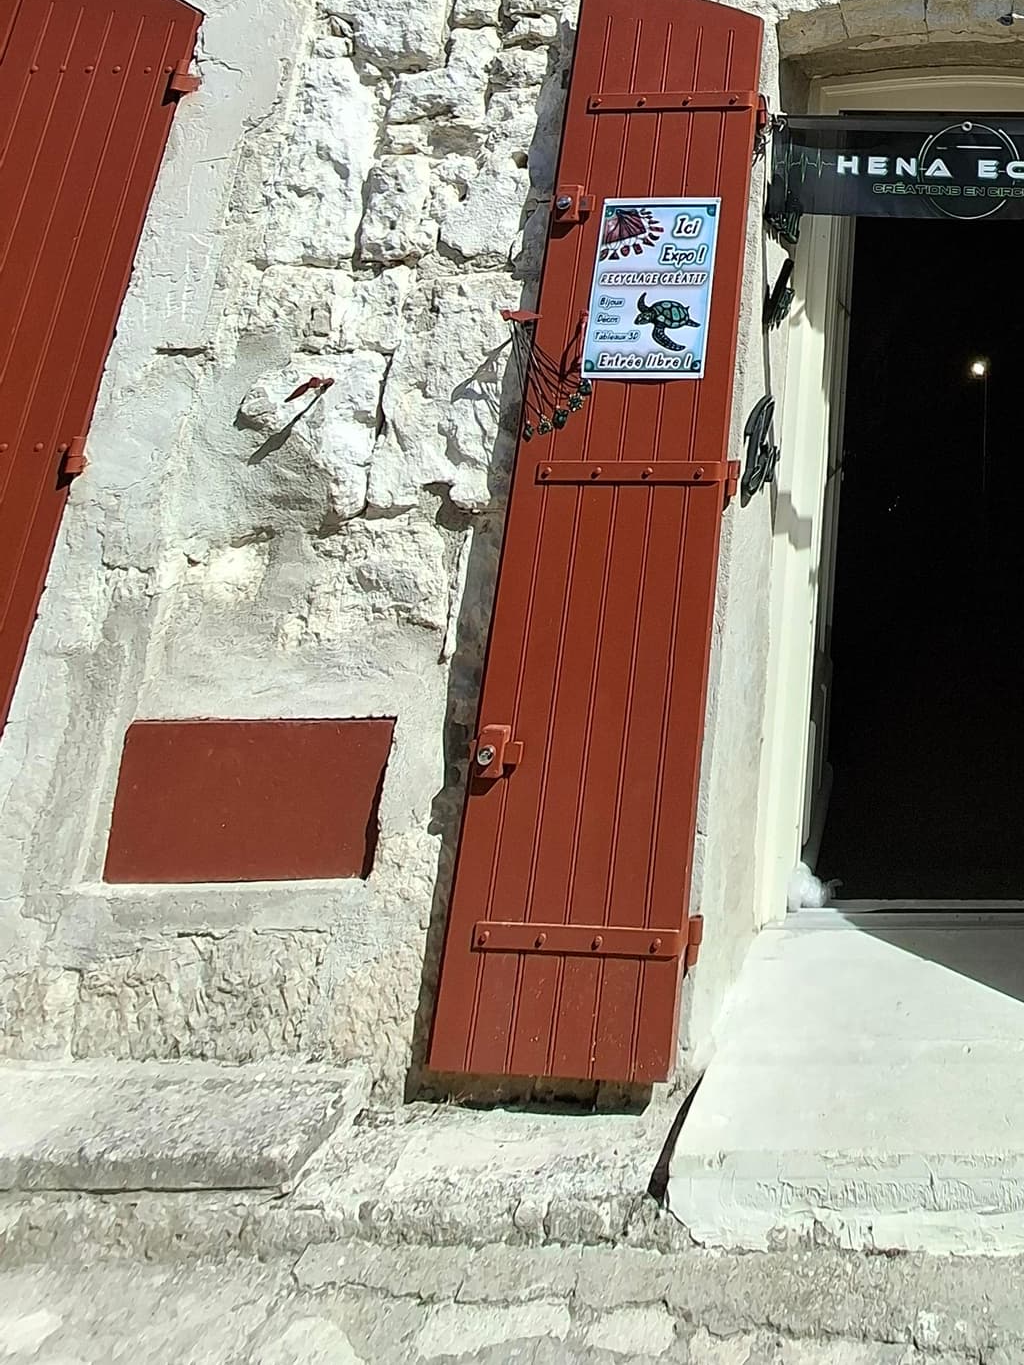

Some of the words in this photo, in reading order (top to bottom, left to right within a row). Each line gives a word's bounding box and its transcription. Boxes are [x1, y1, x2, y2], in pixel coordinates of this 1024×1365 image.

[836, 155, 953, 178] HENA
[872, 182, 961, 196] CRÉATIONS
[963, 186, 986, 197] EN
[676, 217, 700, 235] Ici
[661, 245, 695, 266] Expo
[600, 272, 658, 285] RECYCLAGE
[660, 269, 707, 284] CRÉATIF
[599, 296, 624, 308] Bijoux
[593, 330, 627, 340] Tableaux
[628, 331, 640, 340] 3D
[599, 353, 642, 368] Entrée
[646, 353, 681, 368] libre
